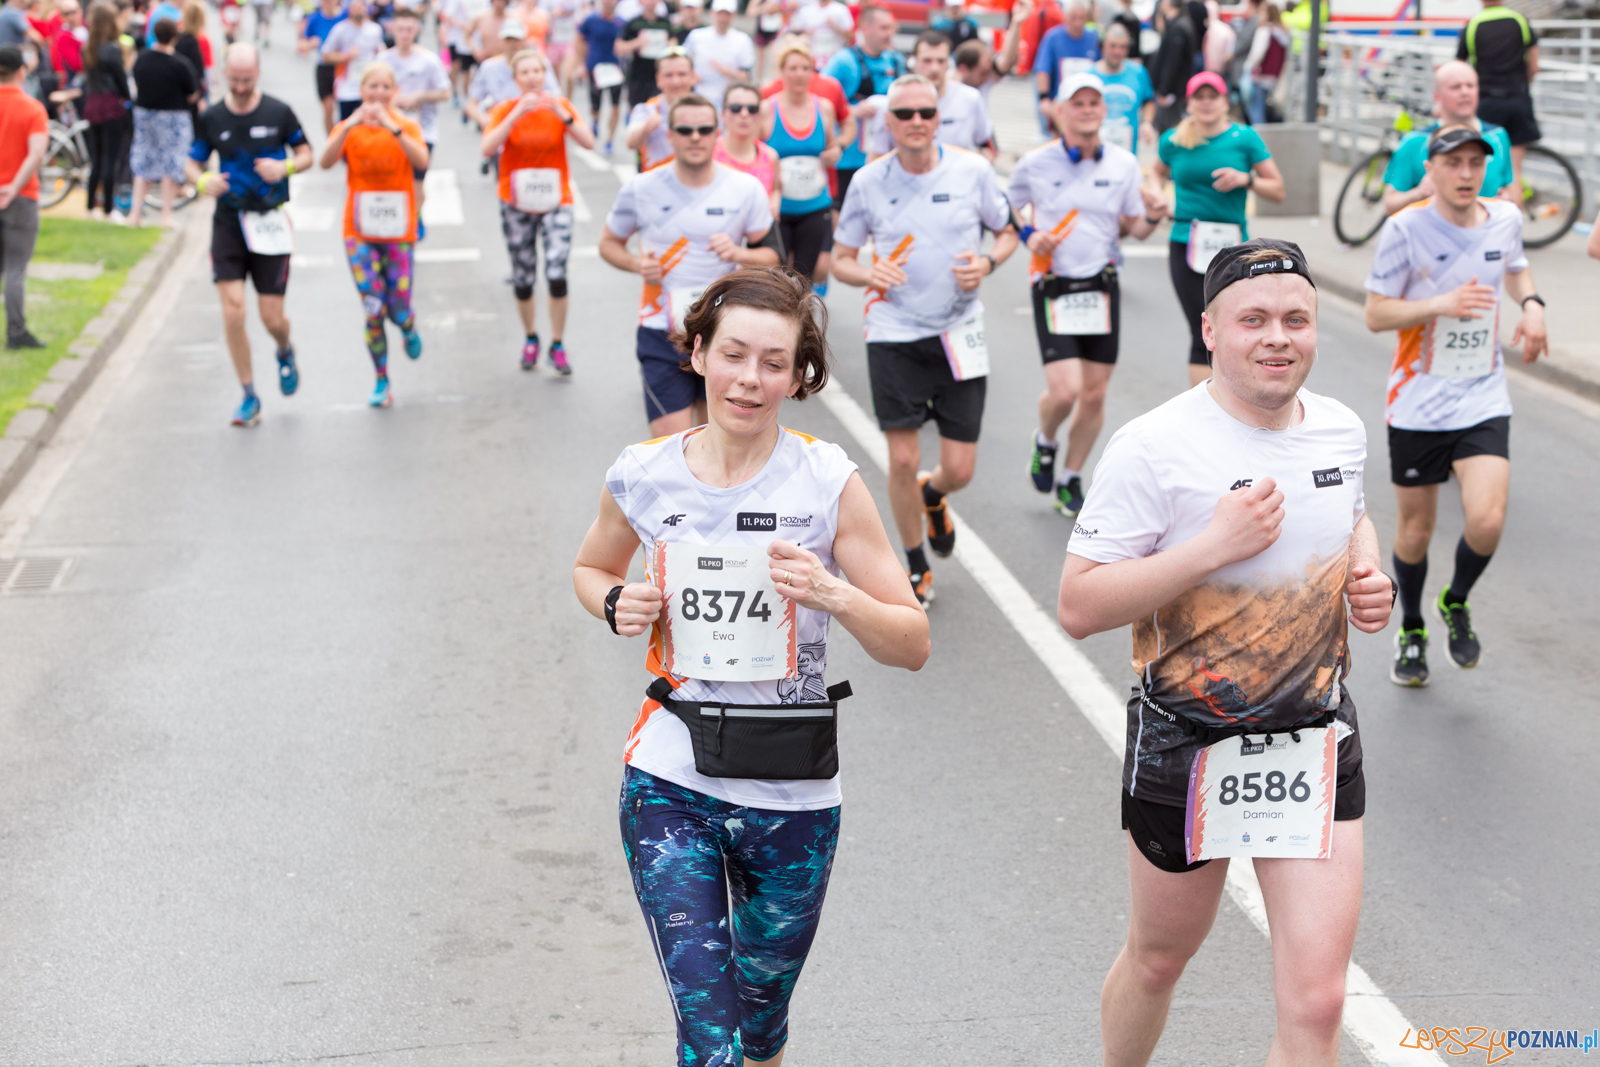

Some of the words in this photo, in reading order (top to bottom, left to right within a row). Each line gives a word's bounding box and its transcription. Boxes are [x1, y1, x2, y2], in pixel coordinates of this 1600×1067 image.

[1445, 328, 1489, 349] 2557
[662, 513, 687, 527] 4F
[681, 587, 772, 623] 8374
[712, 631, 735, 641] Ewa
[726, 658, 740, 666] 4F
[1218, 770, 1311, 806] 8586
[1243, 810, 1284, 819] Damian
[1265, 835, 1279, 843] 4F
